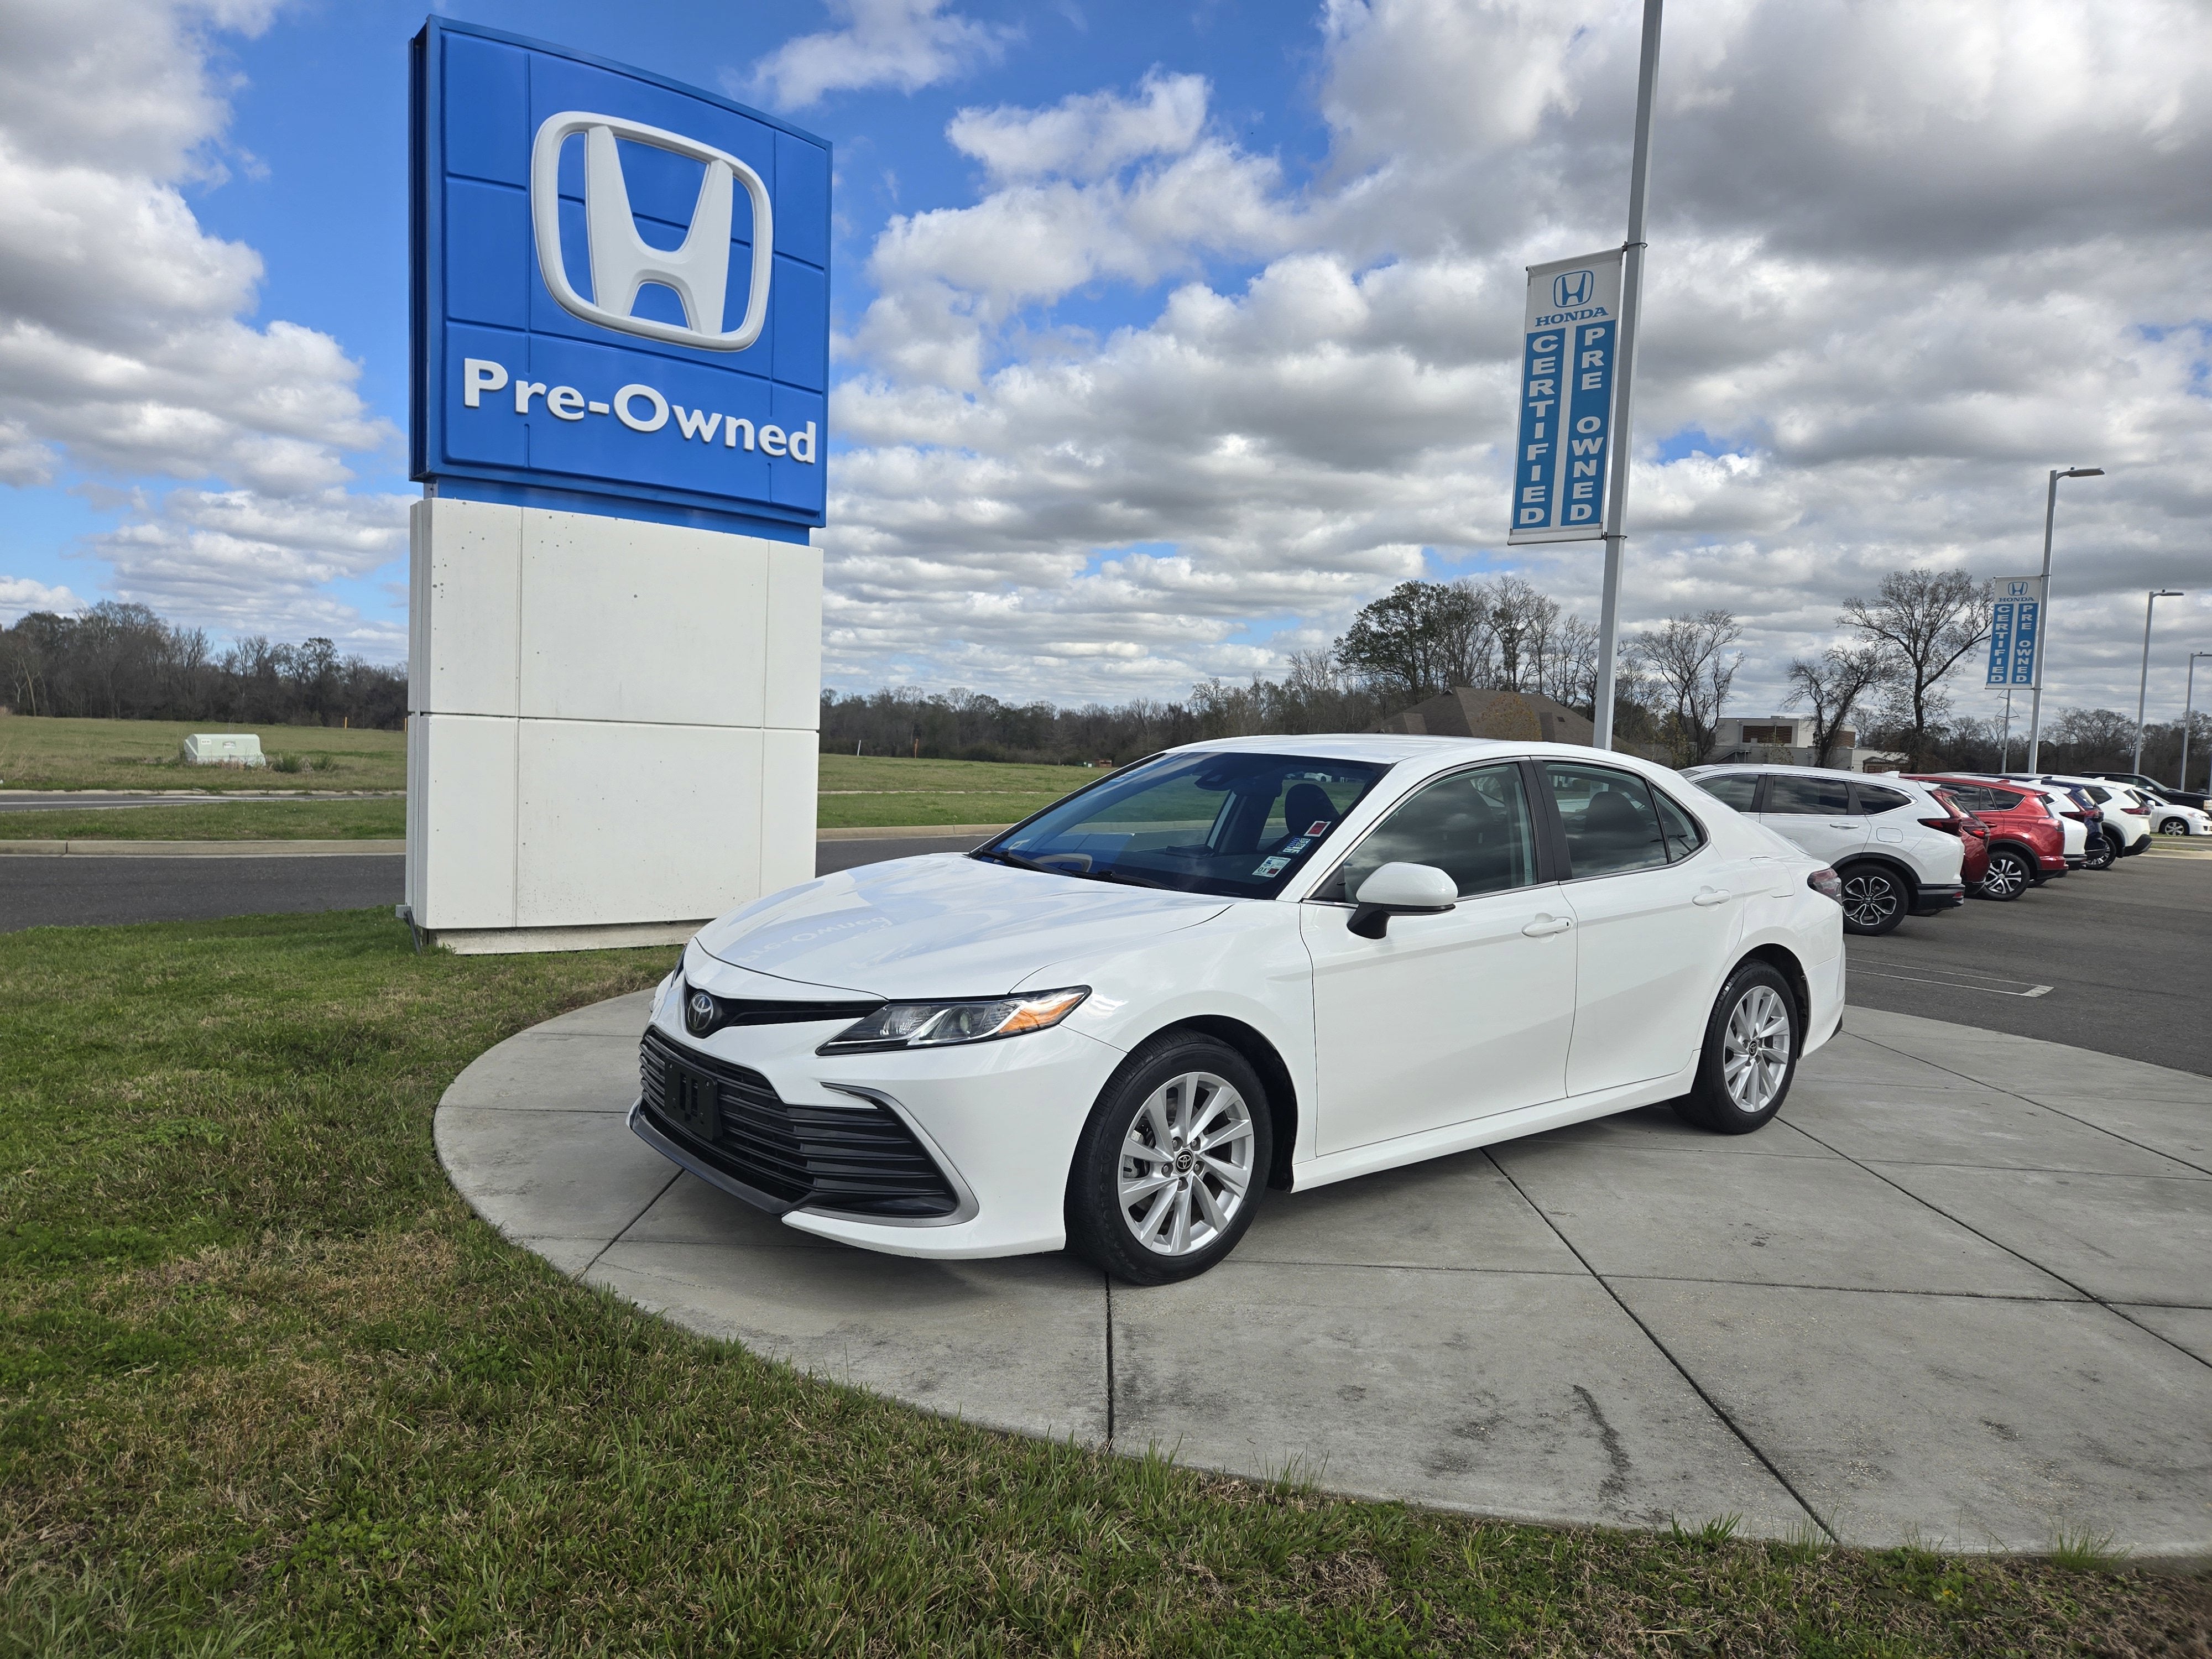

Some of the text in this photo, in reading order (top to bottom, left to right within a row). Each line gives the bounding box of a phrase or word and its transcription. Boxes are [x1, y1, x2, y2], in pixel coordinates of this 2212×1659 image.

[1535, 307, 1609, 327] HONDA
[463, 357, 816, 463] Pre-Owned
[1520, 335, 1559, 524] CERTIFIED
[1570, 327, 1605, 522] PRE OWNED
[1990, 606, 2011, 682] CERTIFIED
[2016, 605, 2033, 682] PRE OWNED
